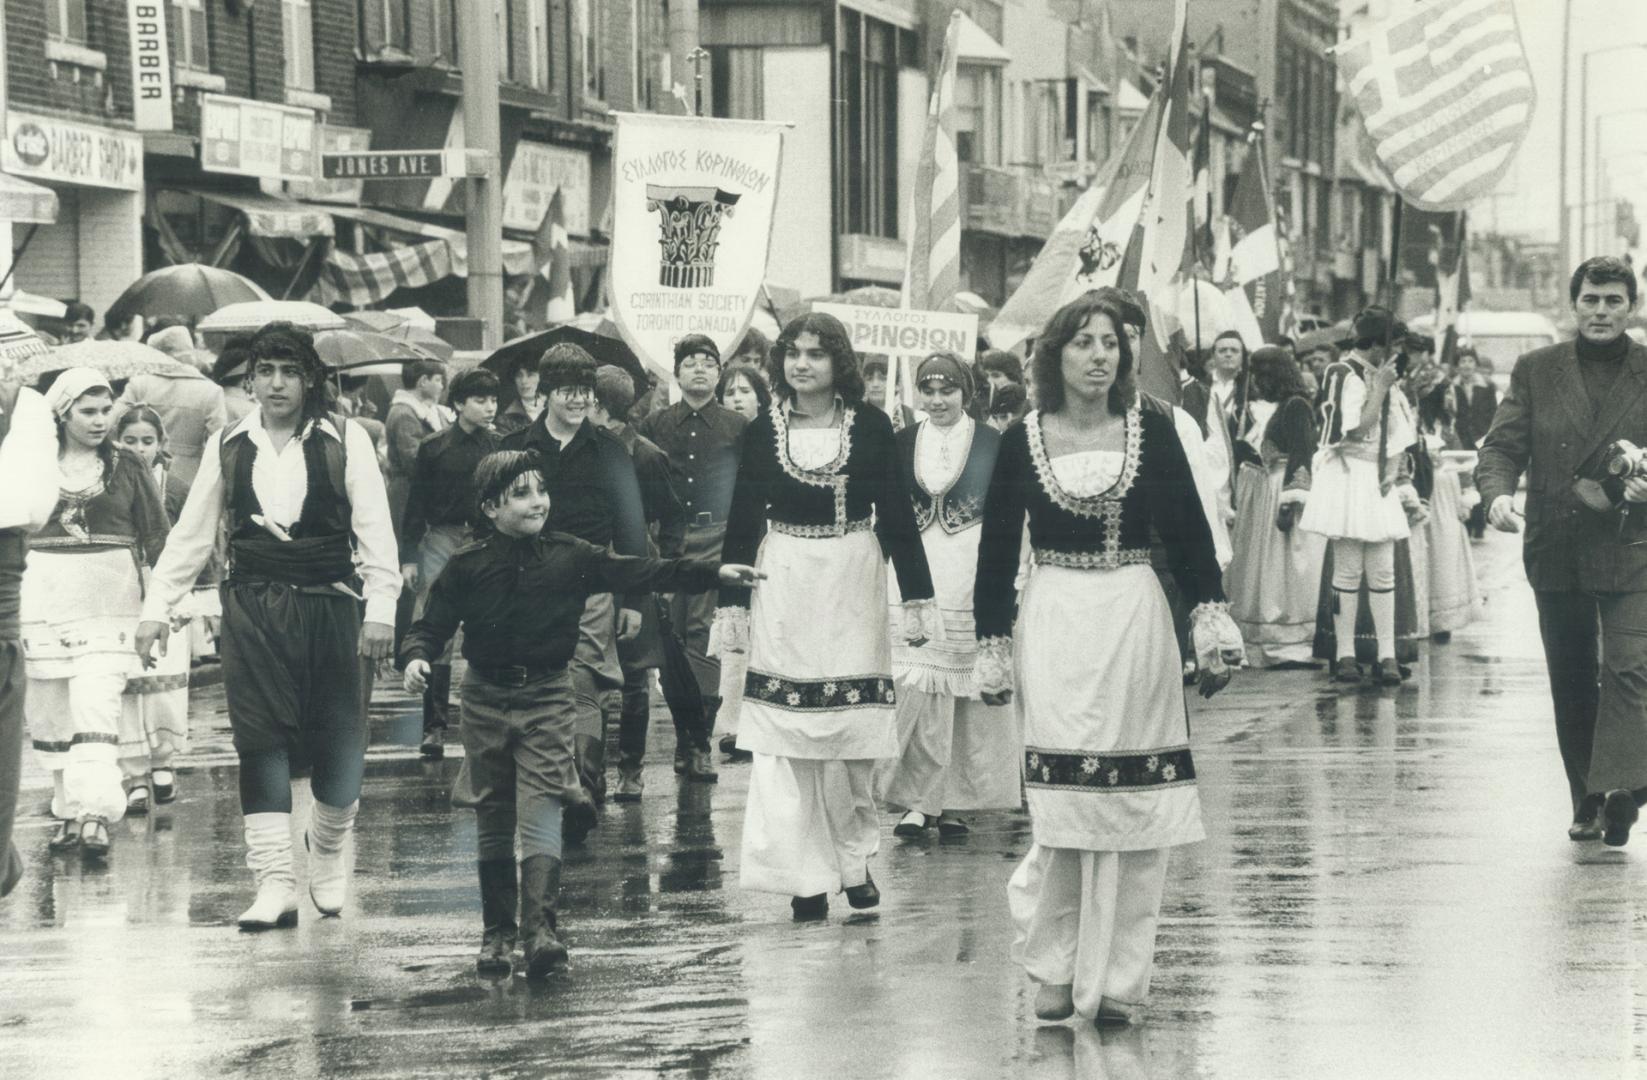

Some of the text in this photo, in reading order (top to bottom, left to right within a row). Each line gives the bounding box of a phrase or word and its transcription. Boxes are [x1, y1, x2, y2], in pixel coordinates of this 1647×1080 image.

[136, 5, 161, 99] BARBER
[335, 156, 389, 176] JONES
[630, 291, 748, 313] CORINTHIAN SOCIETY
[636, 313, 737, 333] TORONTO CANADA
